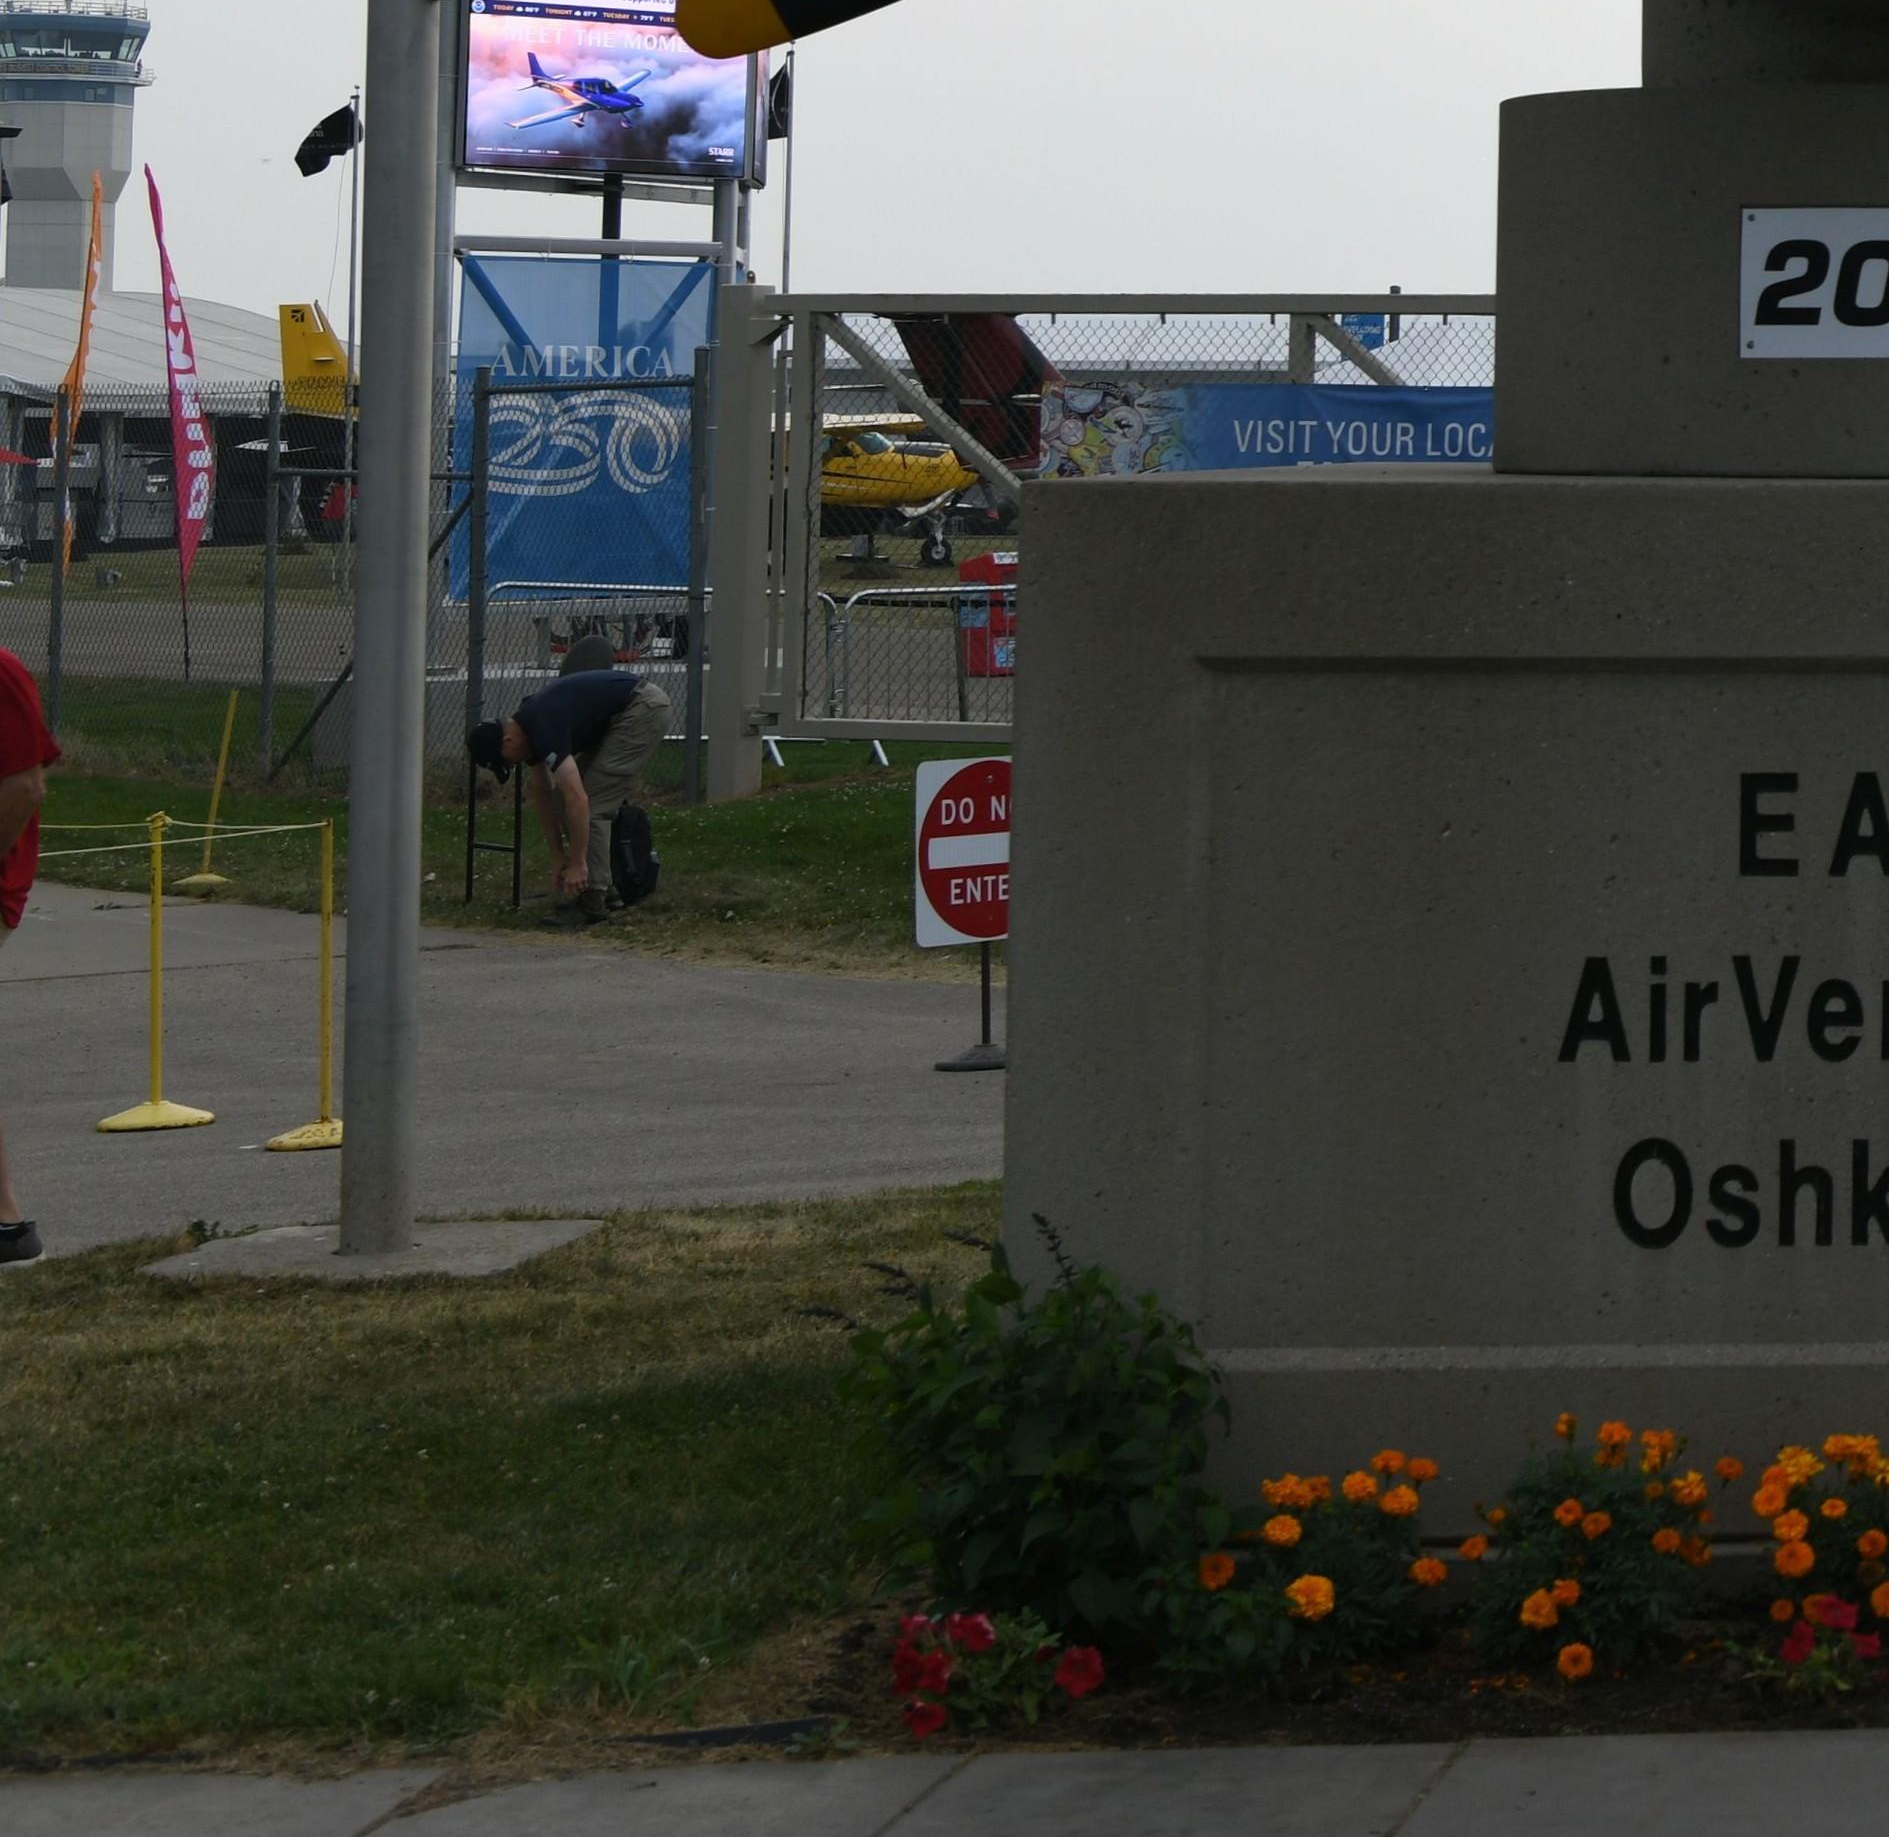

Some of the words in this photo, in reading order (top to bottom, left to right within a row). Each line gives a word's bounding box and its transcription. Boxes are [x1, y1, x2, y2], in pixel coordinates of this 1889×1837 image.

[505, 25, 565, 45] MEET
[576, 31, 617, 48] THE
[707, 146, 735, 157] STARR
[490, 344, 675, 378] AMERICA
[487, 390, 681, 497] 250
[1233, 420, 1318, 454] VISIT
[1326, 420, 1416, 456] YOUR
[1426, 422, 1494, 458] LOC
[941, 797, 975, 826] DO
[990, 795, 1012, 822] N
